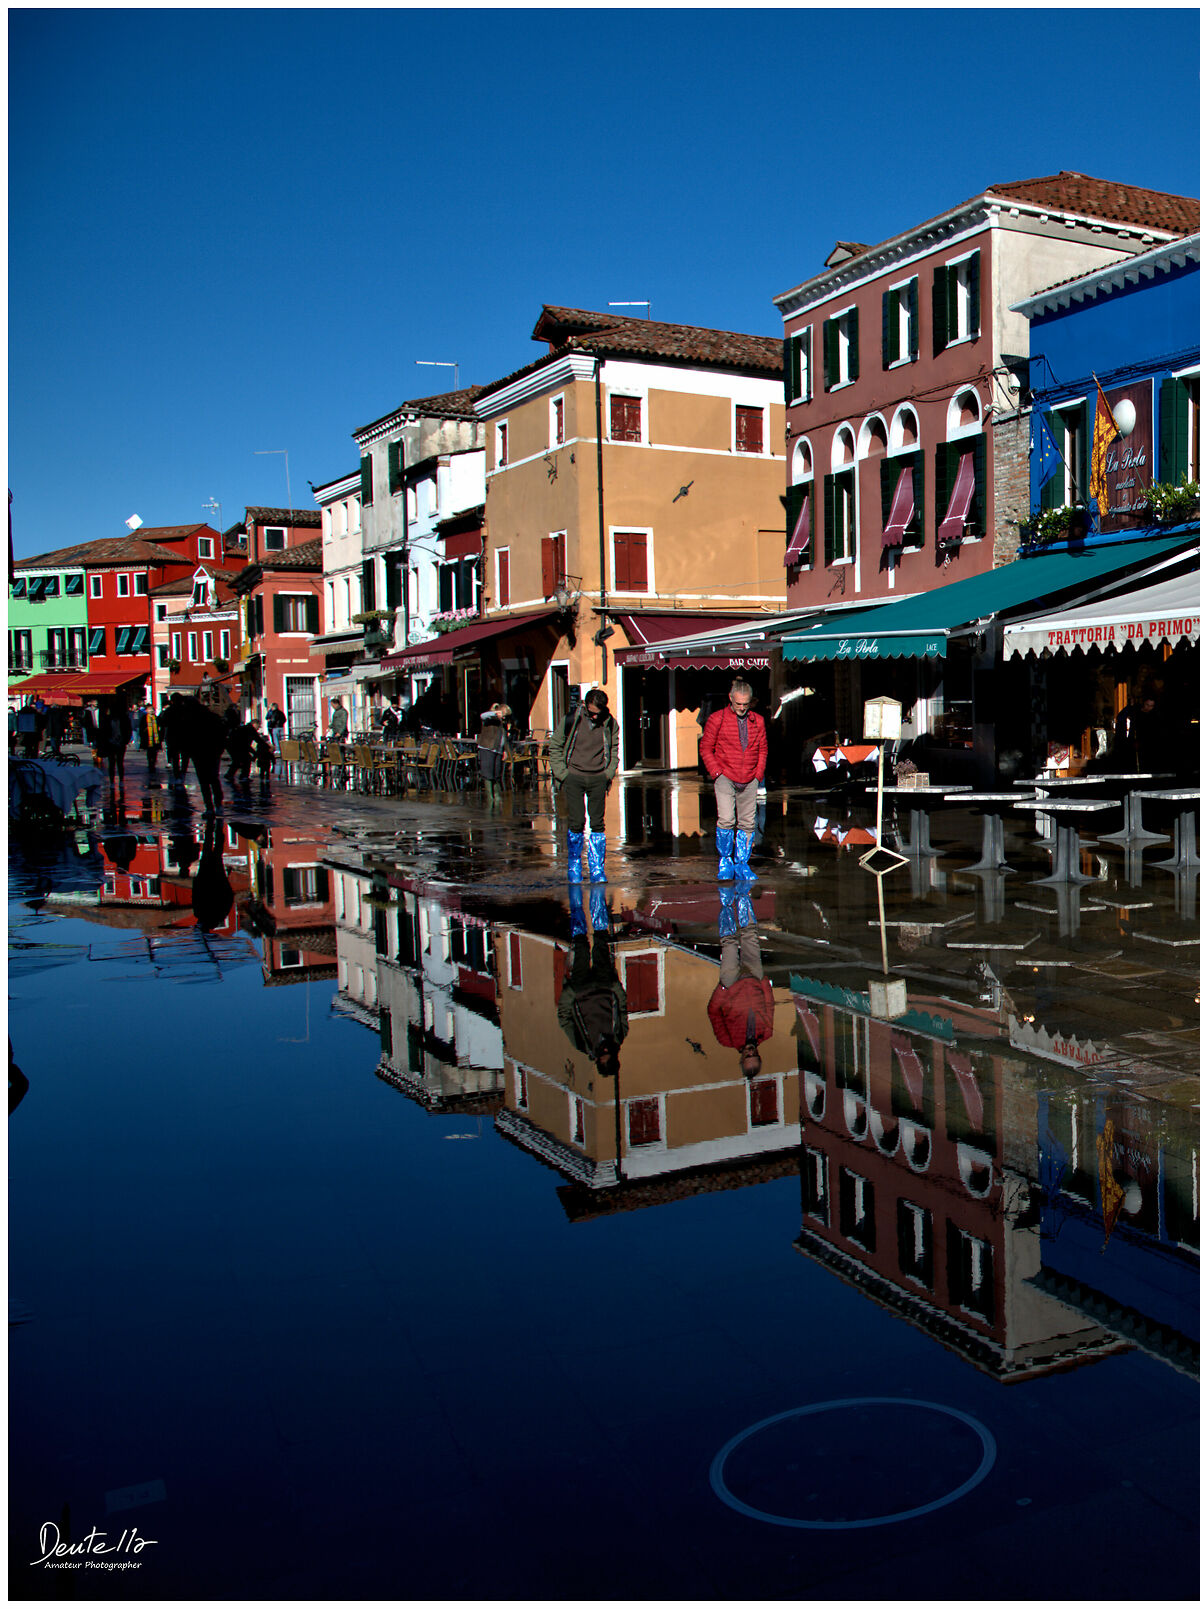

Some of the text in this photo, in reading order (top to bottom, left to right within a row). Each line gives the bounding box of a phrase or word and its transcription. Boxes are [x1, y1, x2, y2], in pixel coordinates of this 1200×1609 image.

[1048, 626, 1115, 645] TRATTORIA
[836, 640, 852, 654] La
[729, 658, 744, 666] BAR
